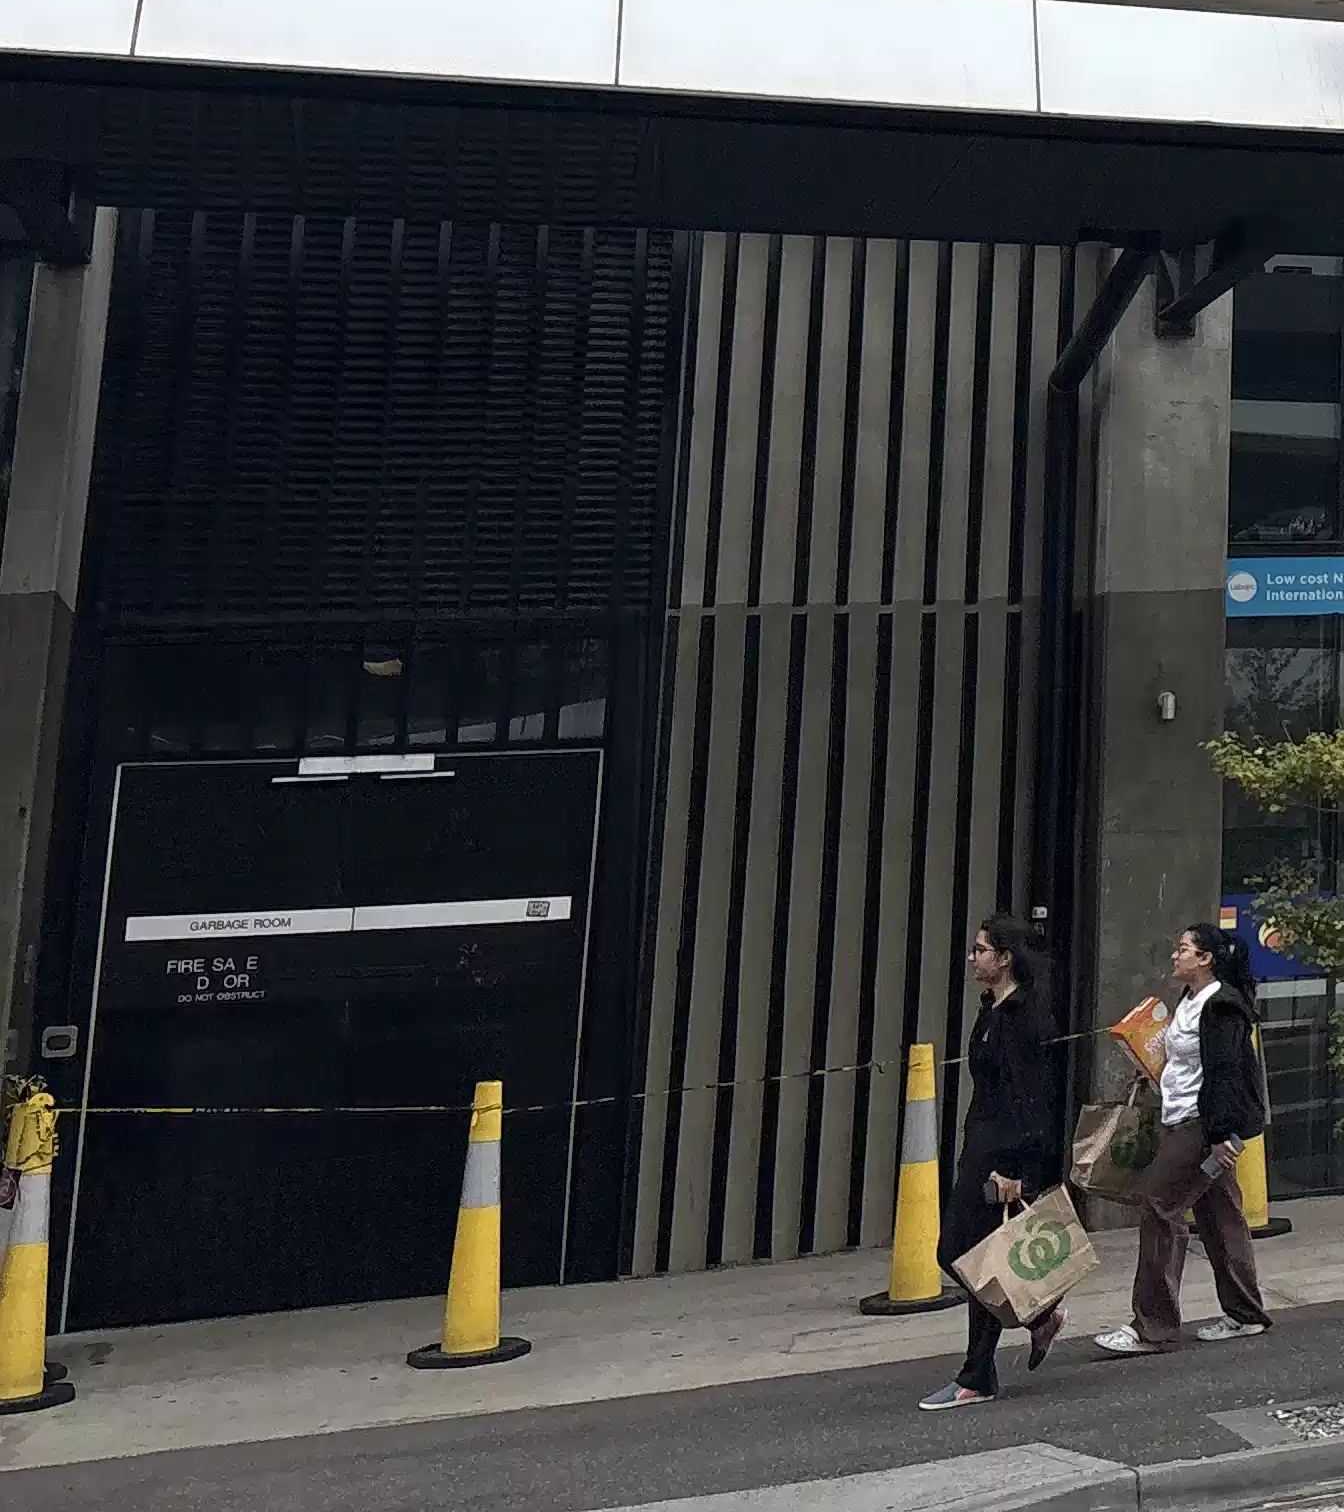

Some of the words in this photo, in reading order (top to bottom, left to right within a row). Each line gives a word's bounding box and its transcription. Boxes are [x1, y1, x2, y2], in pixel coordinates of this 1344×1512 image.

[1266, 573, 1296, 585] Low
[1300, 572, 1329, 585] cost
[189, 920, 249, 932] GARBAGE
[253, 917, 292, 929] ROOM
[166, 959, 205, 974] FIRE
[211, 956, 259, 972] SAE
[177, 994, 193, 1004] DO
[195, 992, 214, 1003] NOT
[216, 990, 266, 1002] OBSTRUCT
